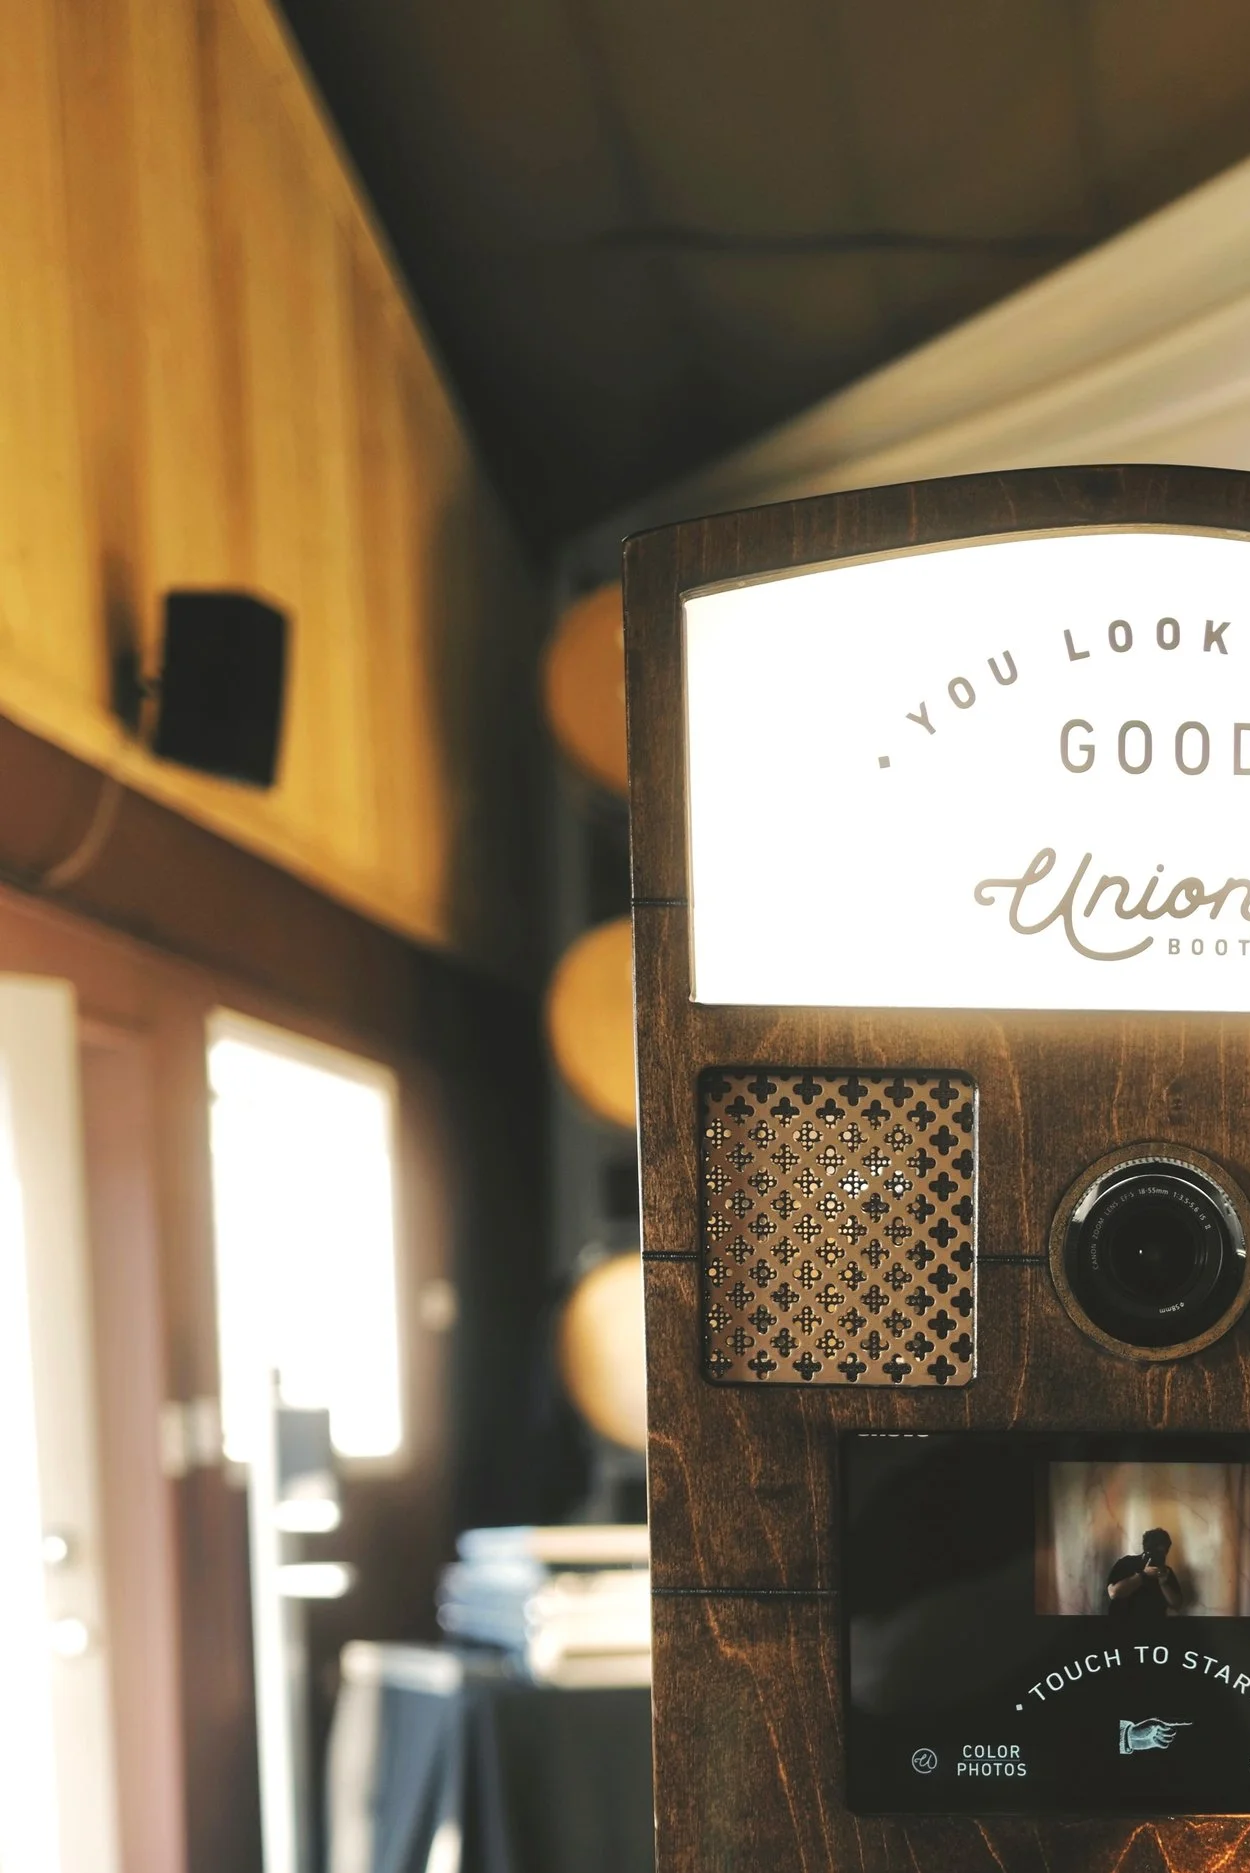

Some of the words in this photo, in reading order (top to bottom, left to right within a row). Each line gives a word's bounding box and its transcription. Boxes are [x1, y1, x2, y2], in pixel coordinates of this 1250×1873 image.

[905, 649, 1019, 736] YOU
[1063, 616, 1232, 662] LOOK
[1104, 1200, 1119, 1216] LENS
[1092, 1217, 1105, 1240] ZOOM
[1090, 1243, 1099, 1271] CANON
[1027, 1648, 1121, 1701] TOUCH
[1133, 1645, 1169, 1665] TO
[962, 1744, 1021, 1759] COLOR
[956, 1762, 1027, 1777] PHOTOS
